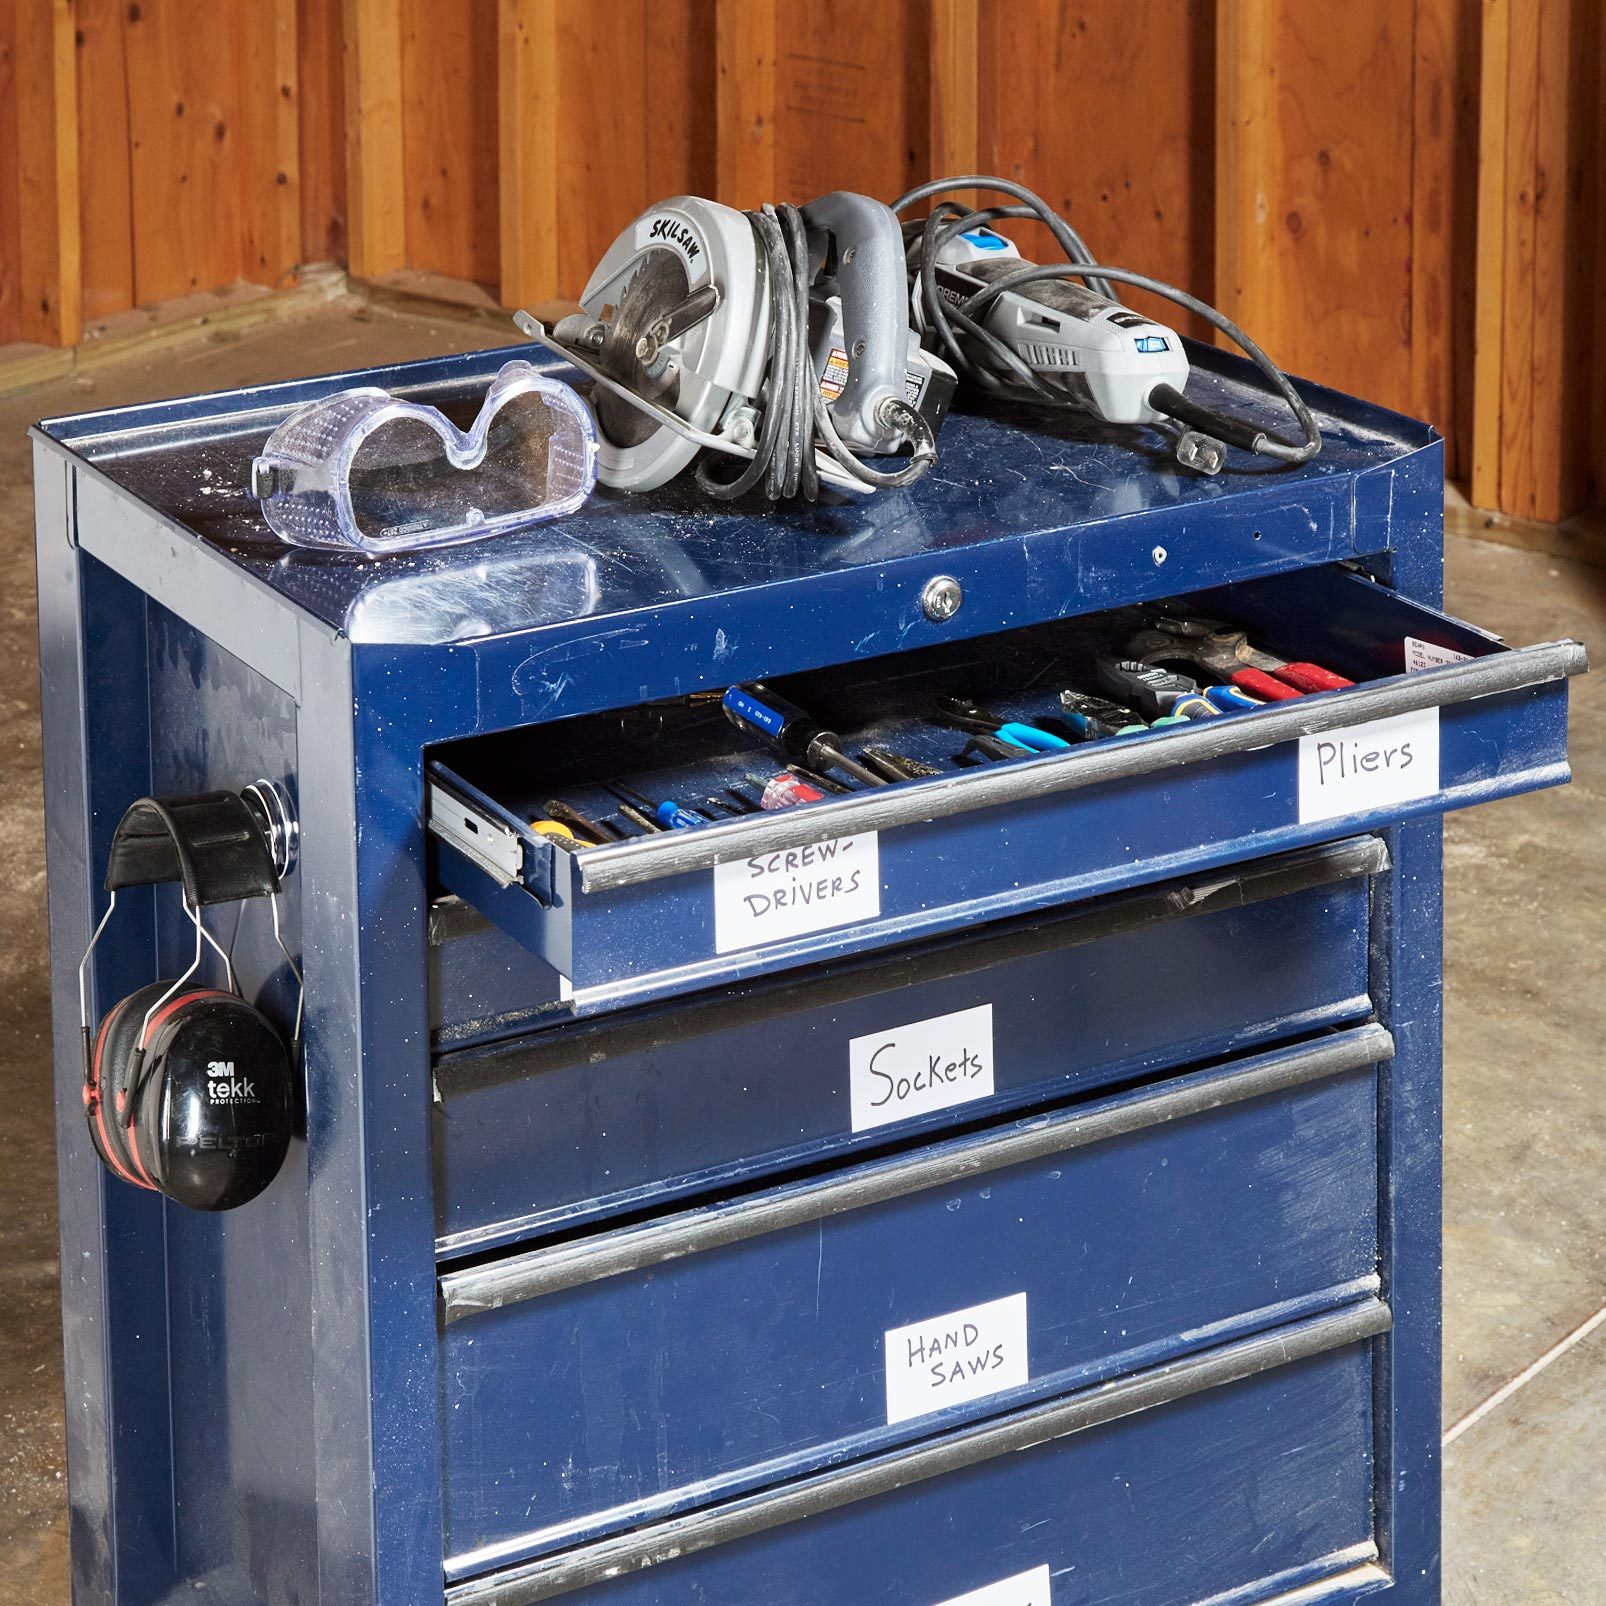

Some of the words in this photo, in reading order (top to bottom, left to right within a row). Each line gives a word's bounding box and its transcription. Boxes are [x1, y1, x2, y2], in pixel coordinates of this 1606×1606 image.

[650, 219, 700, 259] SKILSAW
[1427, 655, 1443, 665] NUMBER
[1317, 741, 1413, 785] Pliers
[747, 839, 853, 878] SCREW-
[206, 1061, 235, 1077] 3M
[207, 1077, 255, 1098] tekk
[870, 1042, 983, 1107] Sockets
[907, 1323, 978, 1367] HAND
[931, 1344, 1004, 1387] SAWS
